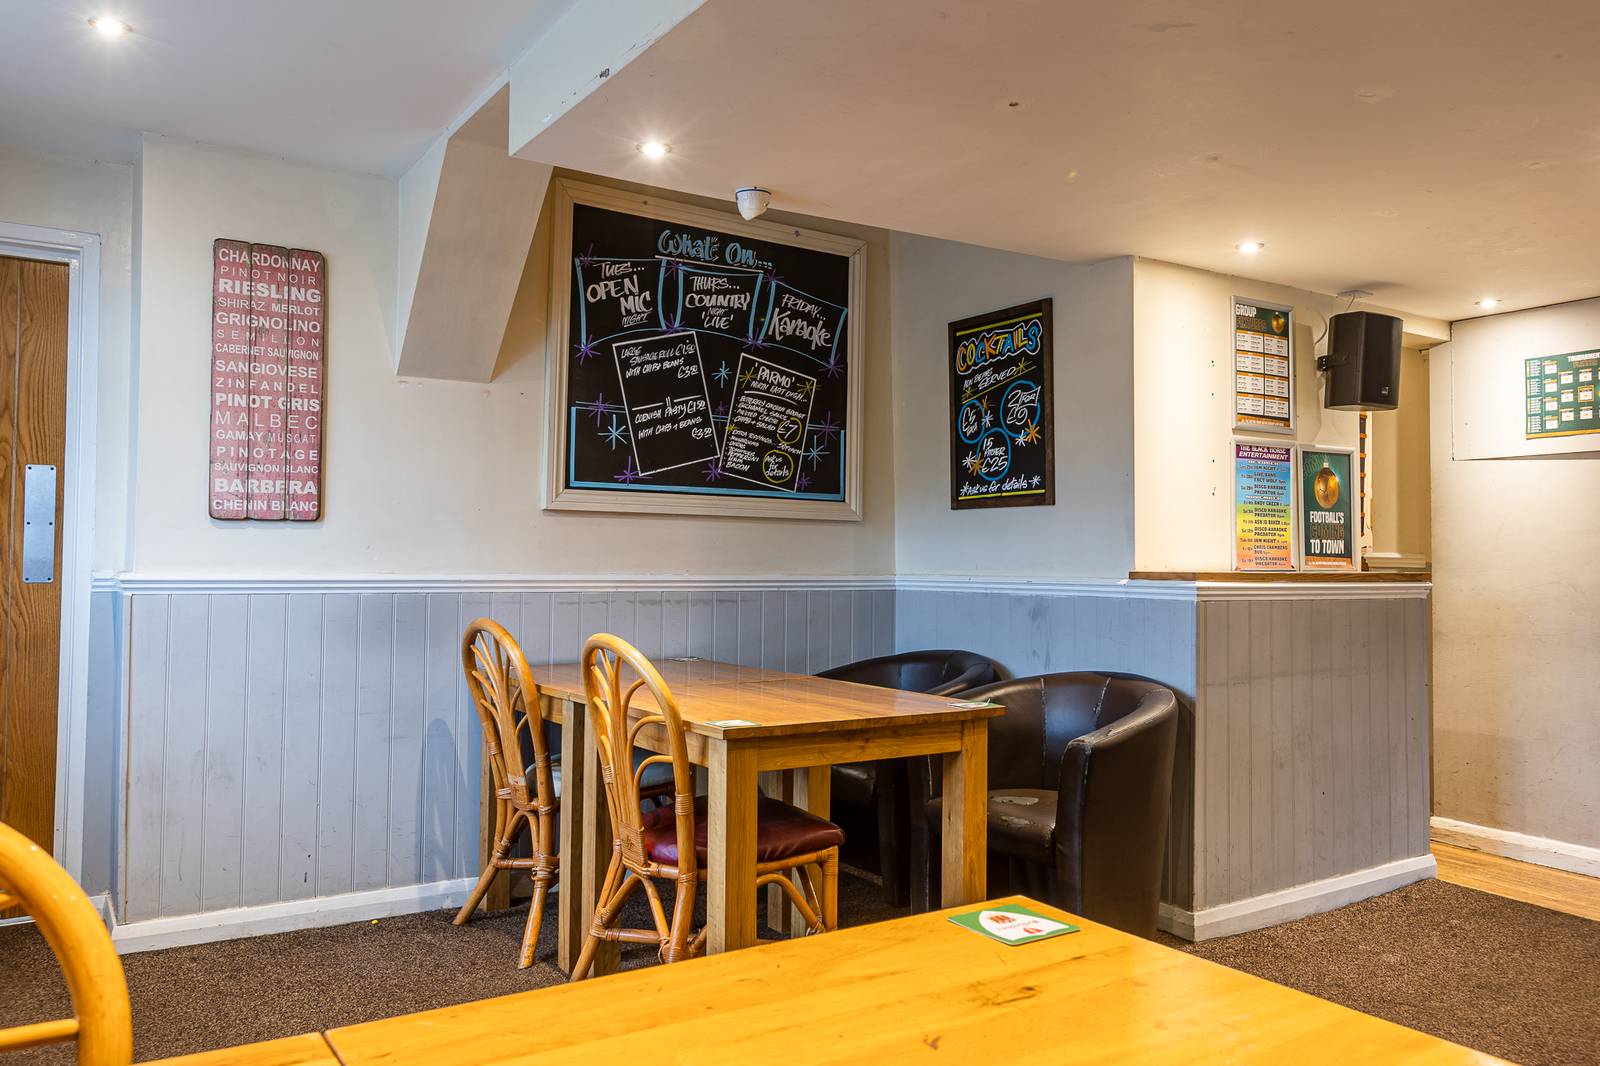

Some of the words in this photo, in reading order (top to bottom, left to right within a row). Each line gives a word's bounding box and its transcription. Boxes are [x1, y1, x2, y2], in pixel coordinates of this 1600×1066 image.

[219, 248, 320, 272] CHARDONNAY
[220, 265, 272, 280] PINOT
[277, 272, 316, 285] NOIR
[218, 278, 321, 303] RIESLING
[586, 274, 639, 303] OPEN
[217, 297, 266, 311] SHIRAZ
[271, 303, 320, 316] MERLOT
[620, 290, 653, 316] MIC
[685, 292, 751, 311] COUNTRY
[621, 312, 652, 326] NIGHT
[707, 307, 728, 317] NIGHT
[1235, 304, 1257, 318] GROUP
[215, 311, 321, 333] GRIGNOLINO
[767, 307, 833, 350] Karaoke
[215, 342, 266, 356] CABERNET
[267, 347, 319, 360] SAUVIGNON
[956, 320, 1041, 374] COCKTAILS
[215, 359, 318, 379] SANGIOVESE
[625, 366, 641, 379] WITH
[662, 356, 684, 370] BEANS
[215, 377, 318, 394] ZINFANDEL
[977, 366, 1017, 390] SERVED
[769, 383, 787, 395] EAST
[215, 392, 272, 409] PINOT
[278, 396, 321, 412] GRIS
[215, 410, 318, 430] MALBEC
[634, 408, 662, 424] CORNISH
[215, 429, 265, 441] GAMAY
[268, 433, 317, 443] MUSCAT
[638, 426, 654, 440] WITH
[655, 422, 672, 435] CHIPS
[679, 416, 703, 429] BEANS
[216, 446, 318, 461] PINOTAGE
[1238, 450, 1289, 460] ENTERTAINMENT
[214, 462, 279, 473] SAUVIGNON
[283, 464, 319, 474] BLANC
[726, 461, 751, 471] BACON
[981, 455, 1008, 473] £25
[214, 478, 318, 495] BARBERA
[1001, 474, 1028, 490] details
[212, 499, 268, 511] CHENIN
[271, 500, 318, 512] BLANC
[1310, 511, 1345, 524] FOOTBALL'S
[1310, 540, 1320, 554] TO
[1322, 540, 1345, 554] TOWN
